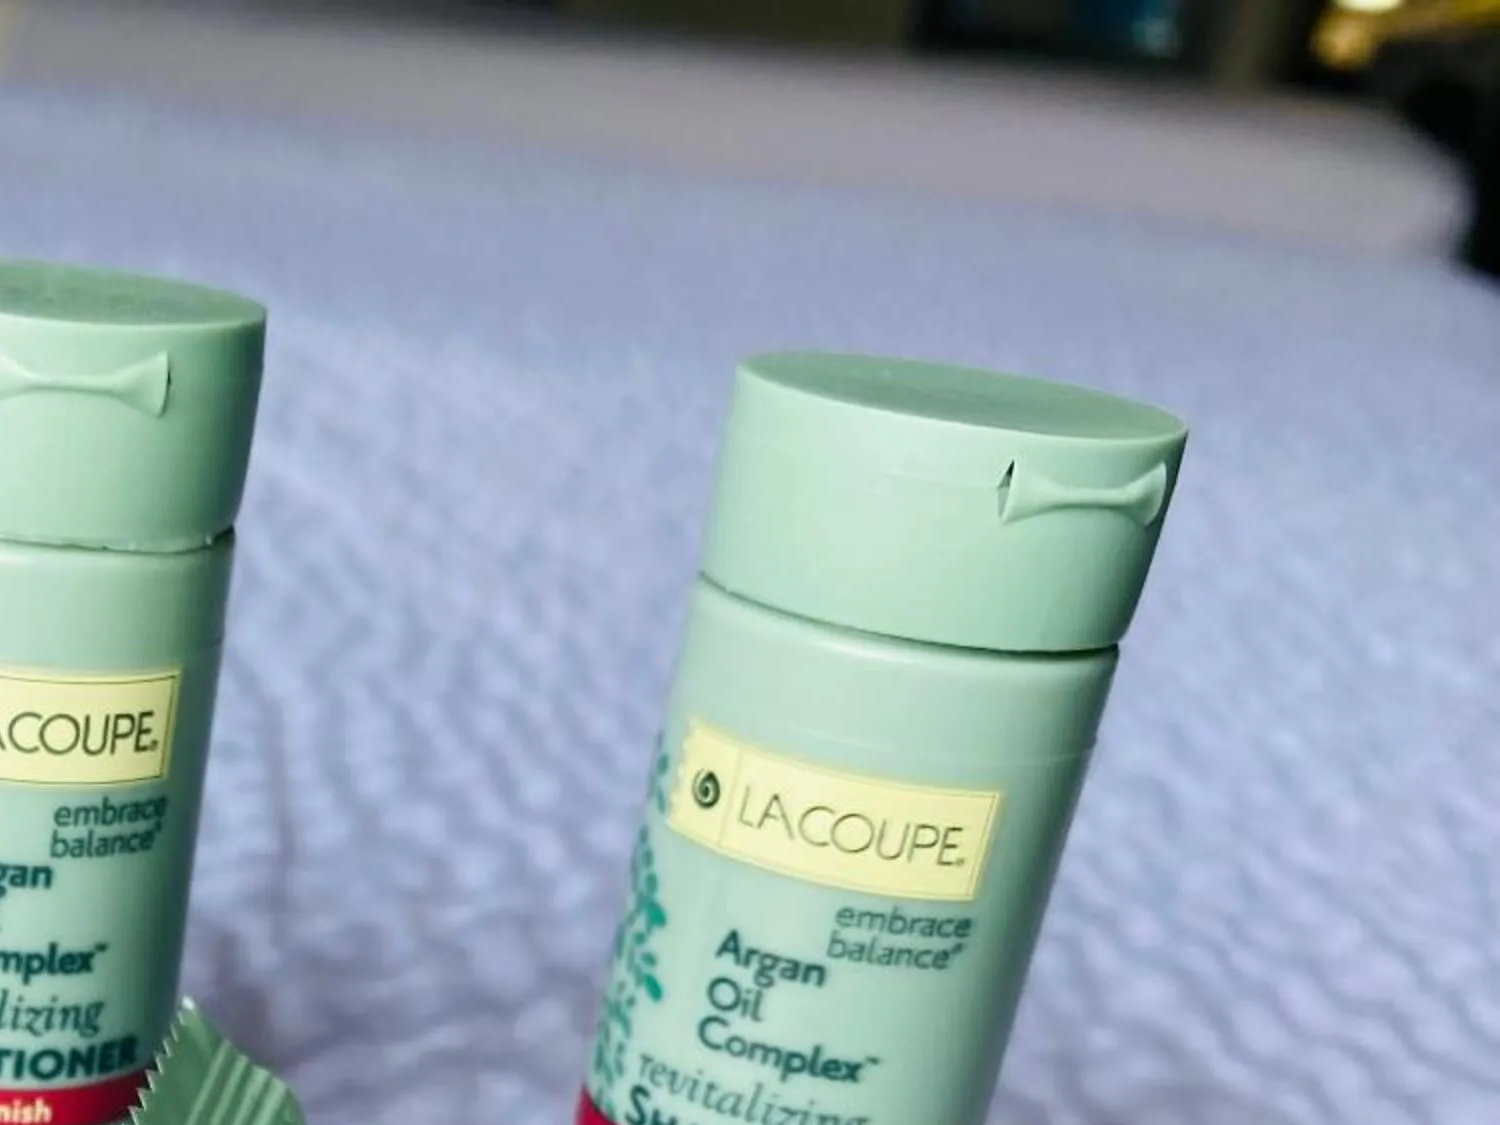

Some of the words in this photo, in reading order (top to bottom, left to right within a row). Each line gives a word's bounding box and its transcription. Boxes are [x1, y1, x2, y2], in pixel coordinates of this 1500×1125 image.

[53, 795, 169, 828] embrace
[835, 906, 973, 938] embrace
[715, 929, 828, 988] Argan
[707, 976, 764, 1023] Oil
